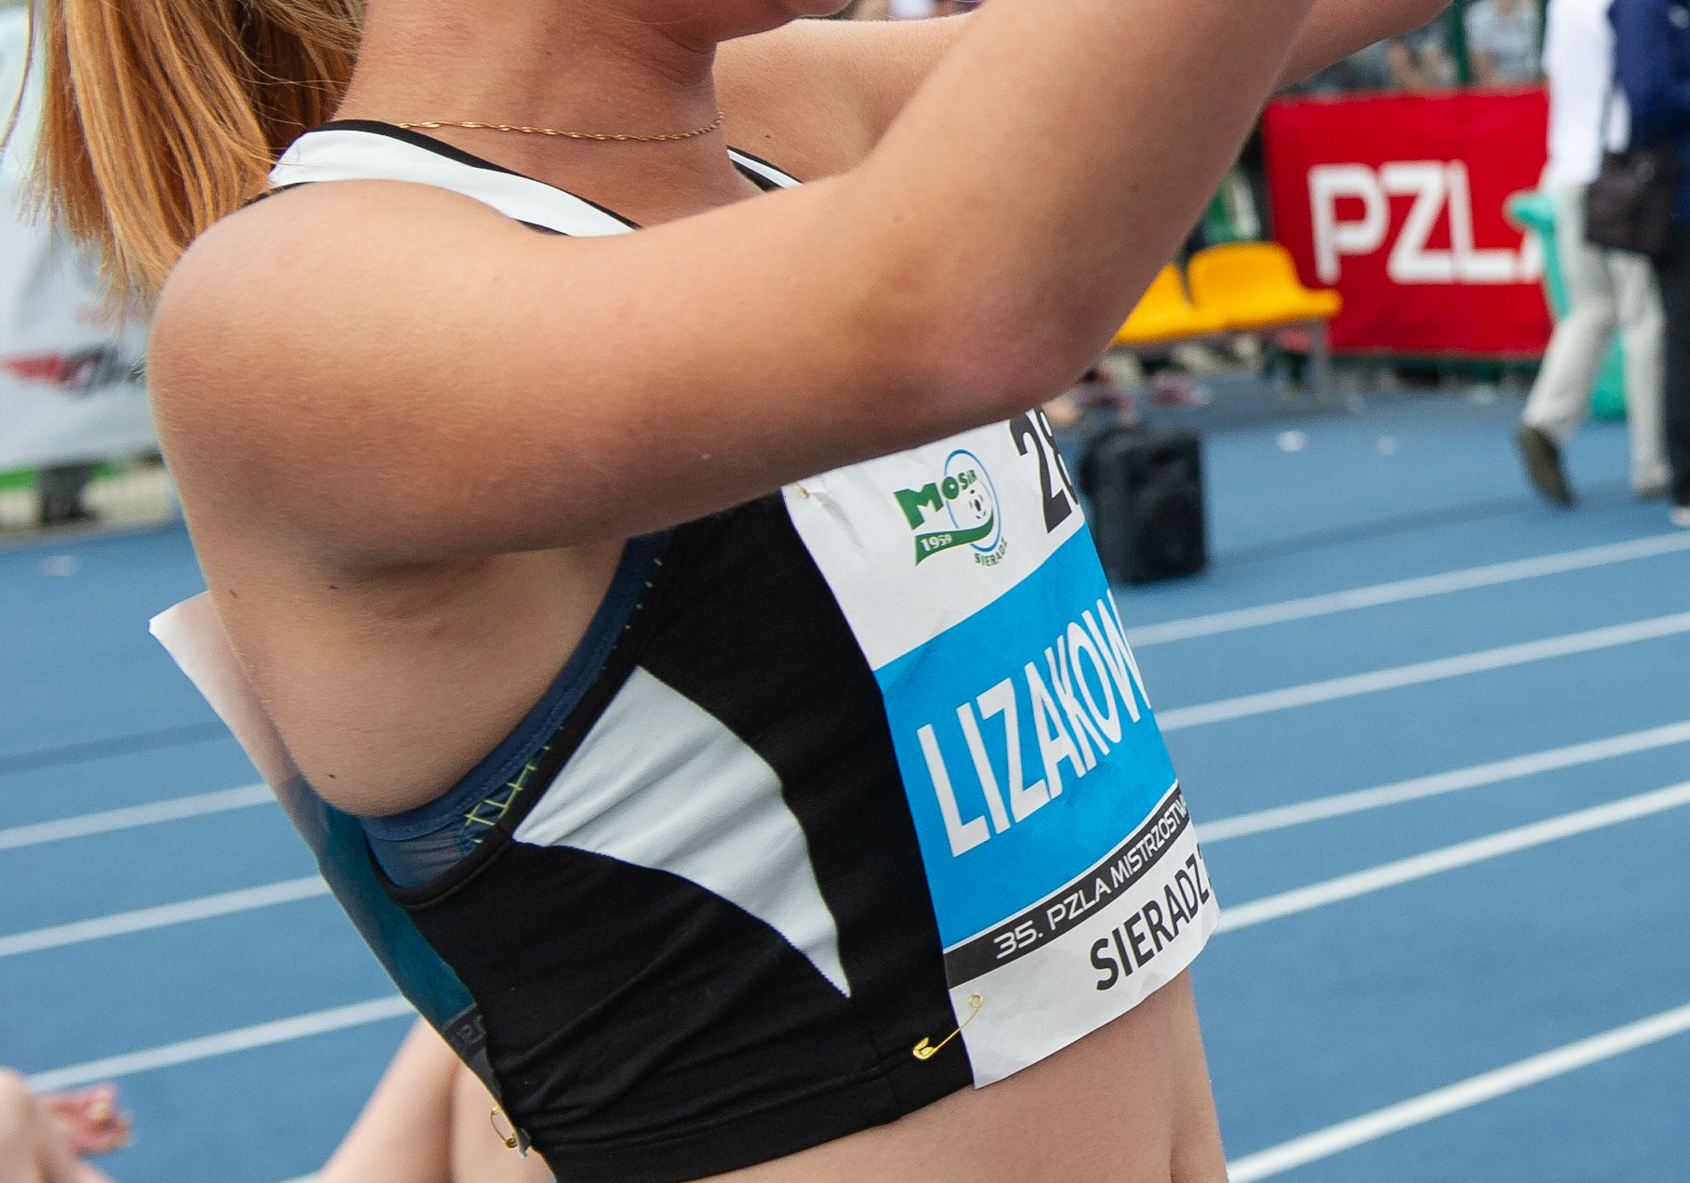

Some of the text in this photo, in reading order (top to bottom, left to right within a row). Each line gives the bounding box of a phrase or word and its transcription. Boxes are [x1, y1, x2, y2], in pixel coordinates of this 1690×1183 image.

[920, 533, 953, 552] 1959
[974, 536, 1008, 567] SIERADZ
[917, 588, 1152, 858] LIZAKOW
[993, 919, 1043, 960] 35.
[1046, 877, 1112, 931] PZLA
[1090, 853, 1211, 991] SIERADZ
